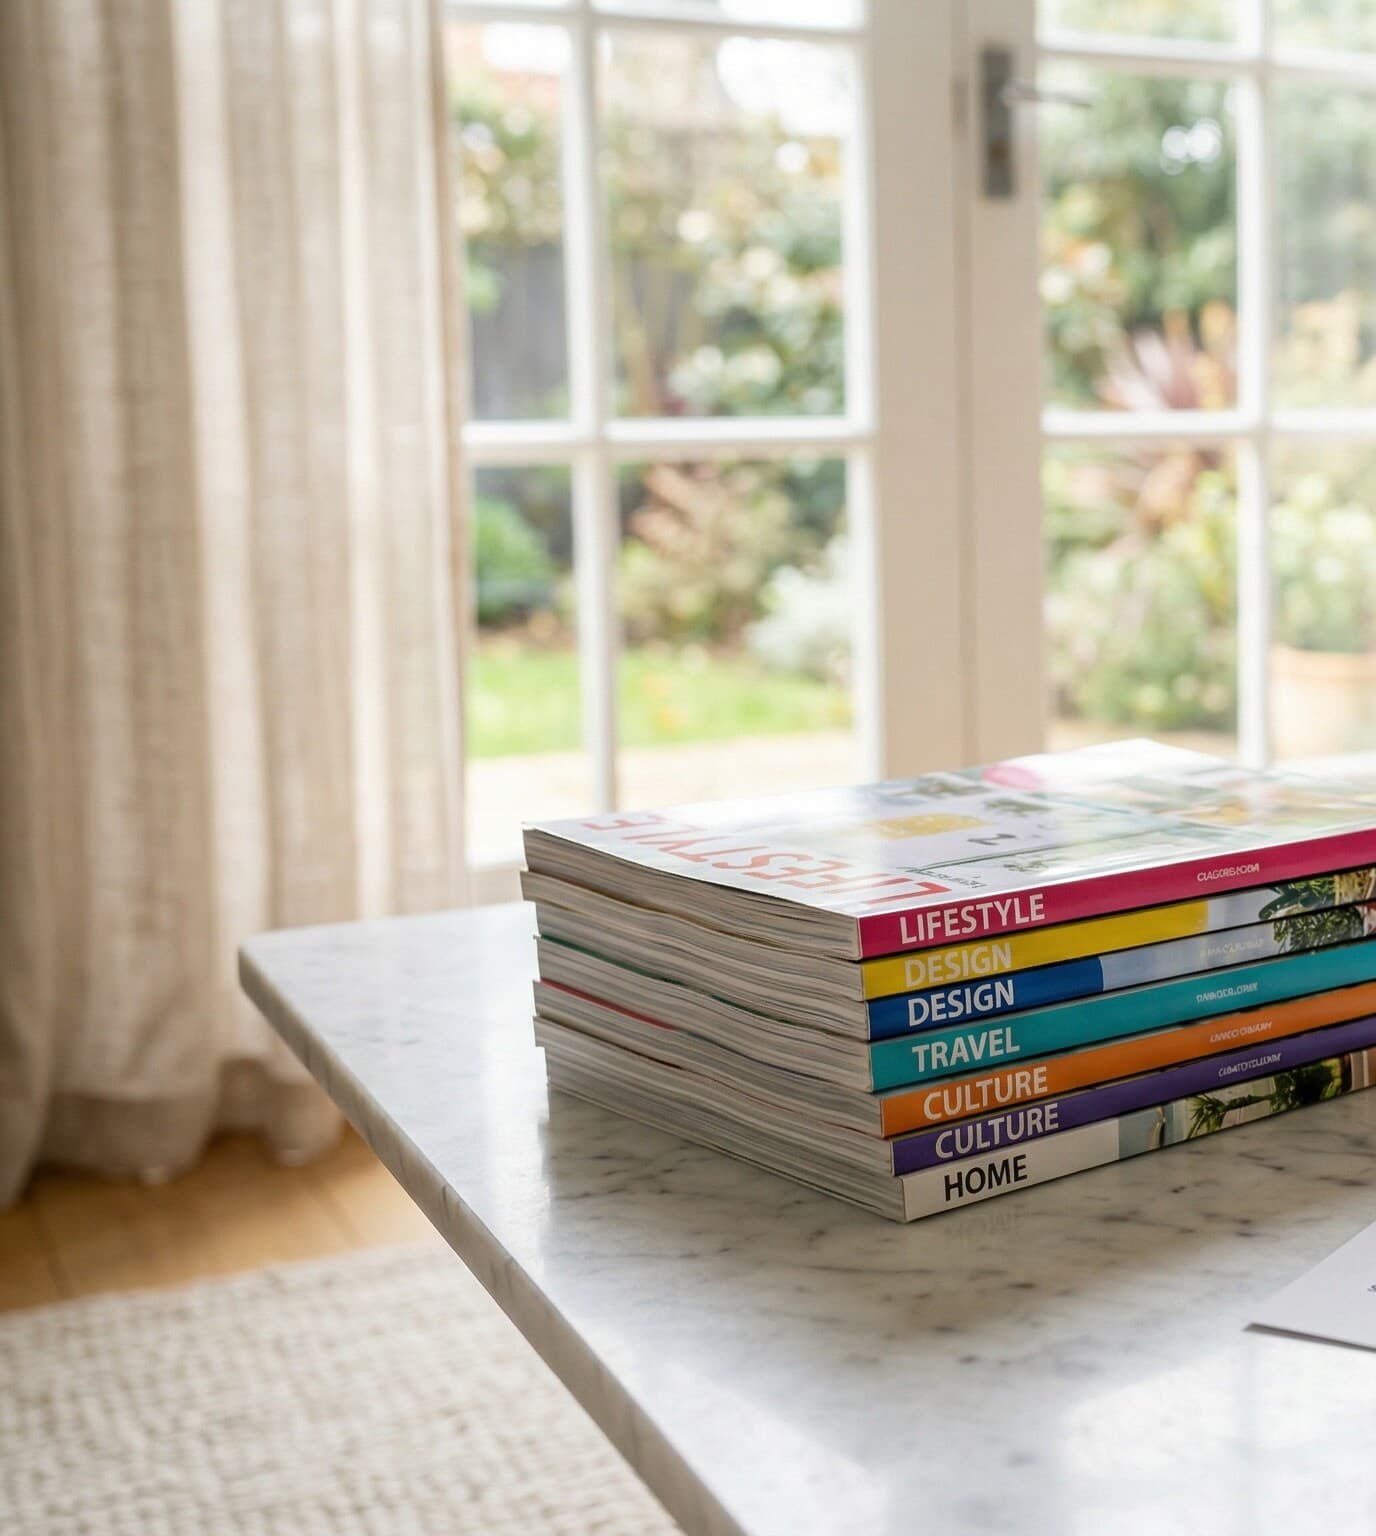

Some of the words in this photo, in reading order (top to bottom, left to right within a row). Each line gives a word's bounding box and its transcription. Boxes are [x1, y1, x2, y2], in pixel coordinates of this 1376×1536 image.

[900, 893, 1045, 944] LIFESTYLE
[905, 942, 1012, 988] DESIGN
[908, 979, 1014, 1027] DESIGN
[912, 1027, 1020, 1072] TRAVEL
[923, 1066, 1048, 1120] CULTURE
[935, 1102, 1059, 1159] CULTURE
[944, 1153, 1028, 1201] HOME
